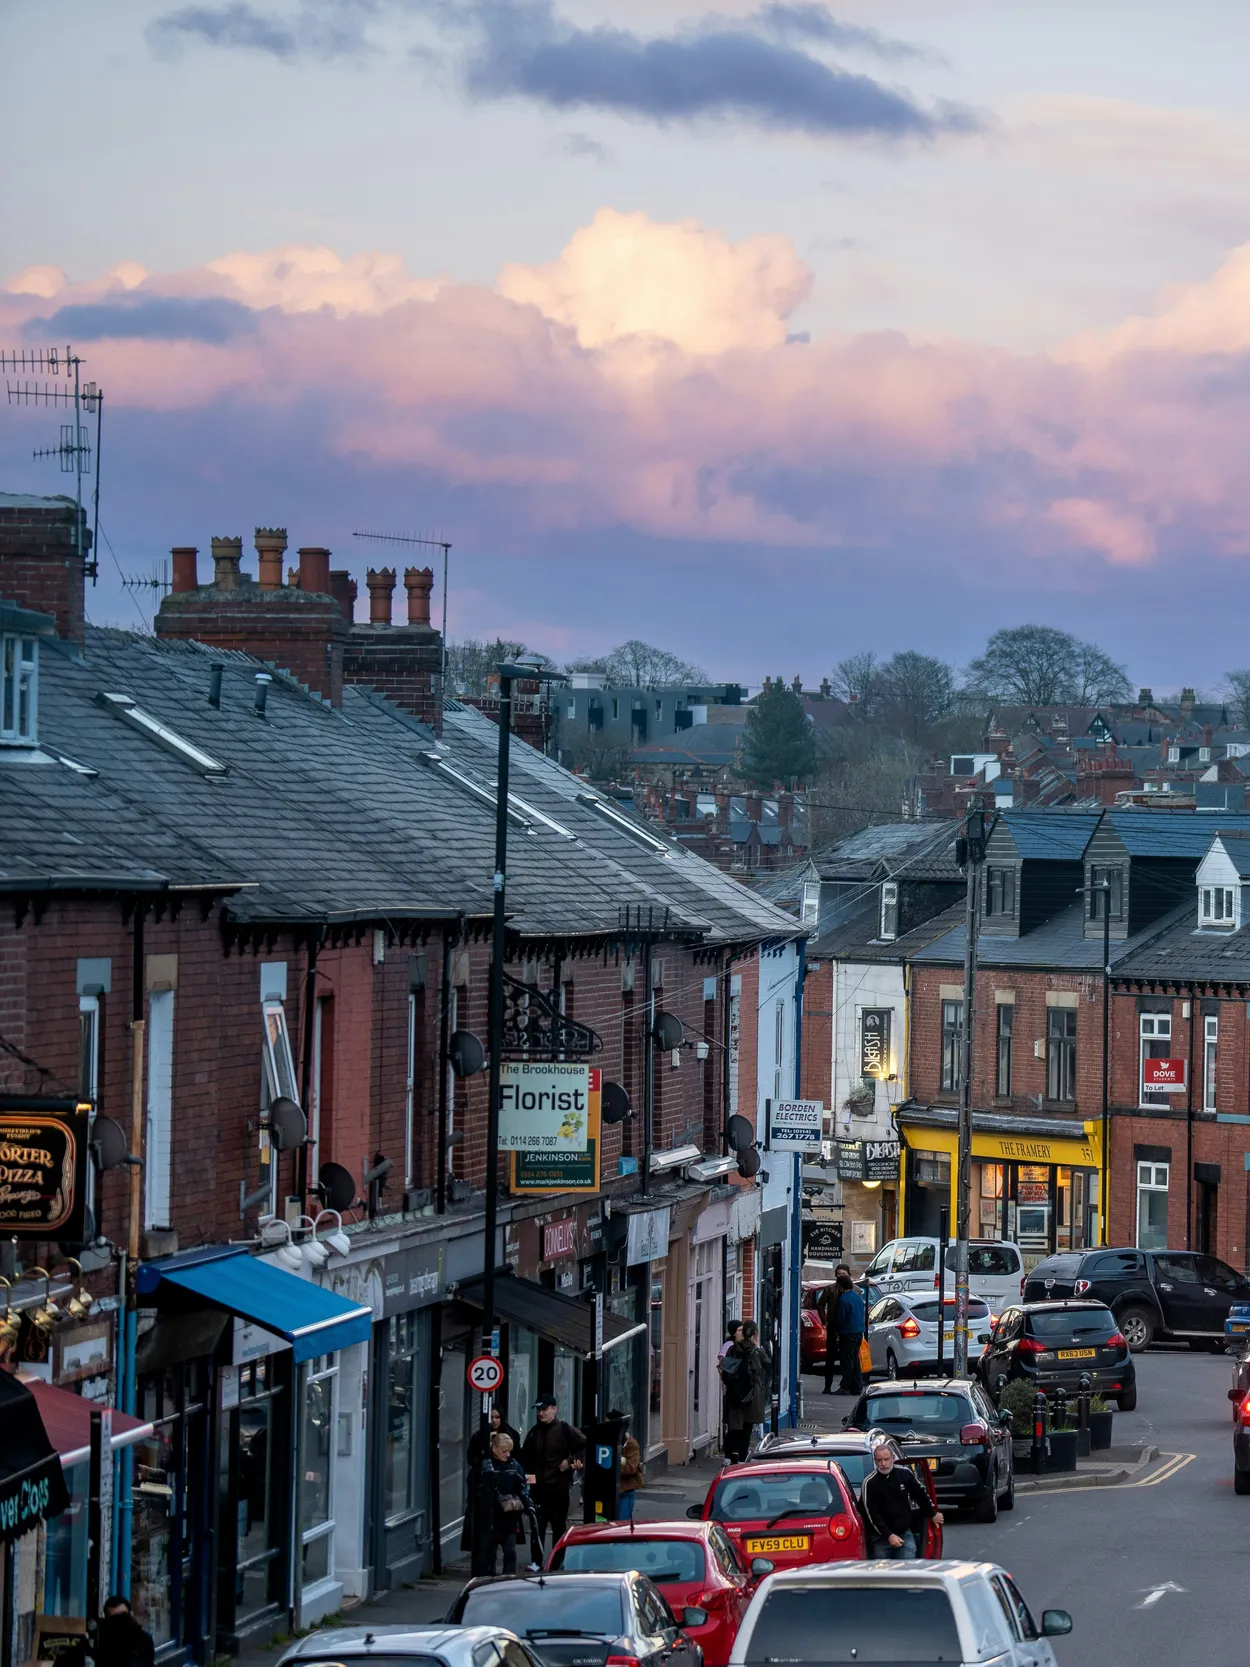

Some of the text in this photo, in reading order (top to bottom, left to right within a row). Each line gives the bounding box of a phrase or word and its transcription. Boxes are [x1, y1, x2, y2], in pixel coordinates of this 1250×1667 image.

[500, 1064, 585, 1075] The Brookhouse
[499, 1084, 585, 1111] Florist
[778, 1103, 816, 1113] BORDEN
[775, 1112, 818, 1122] ELECTRICS
[510, 1136, 526, 1146] 0114
[527, 1136, 541, 1146] 266
[541, 1136, 558, 1146] 7087
[999, 1141, 1094, 1161] THE FRAMERY 351
[525, 1153, 578, 1162] JENKINSON
[810, 1227, 841, 1237] EVE KITCHEN
[886, 1280, 912, 1292] TAXI
[1060, 1350, 1079, 1358] RX63
[474, 1366, 498, 1381] 20
[598, 1447, 610, 1465] P
[751, 1538, 804, 1551] FV59 CLU
